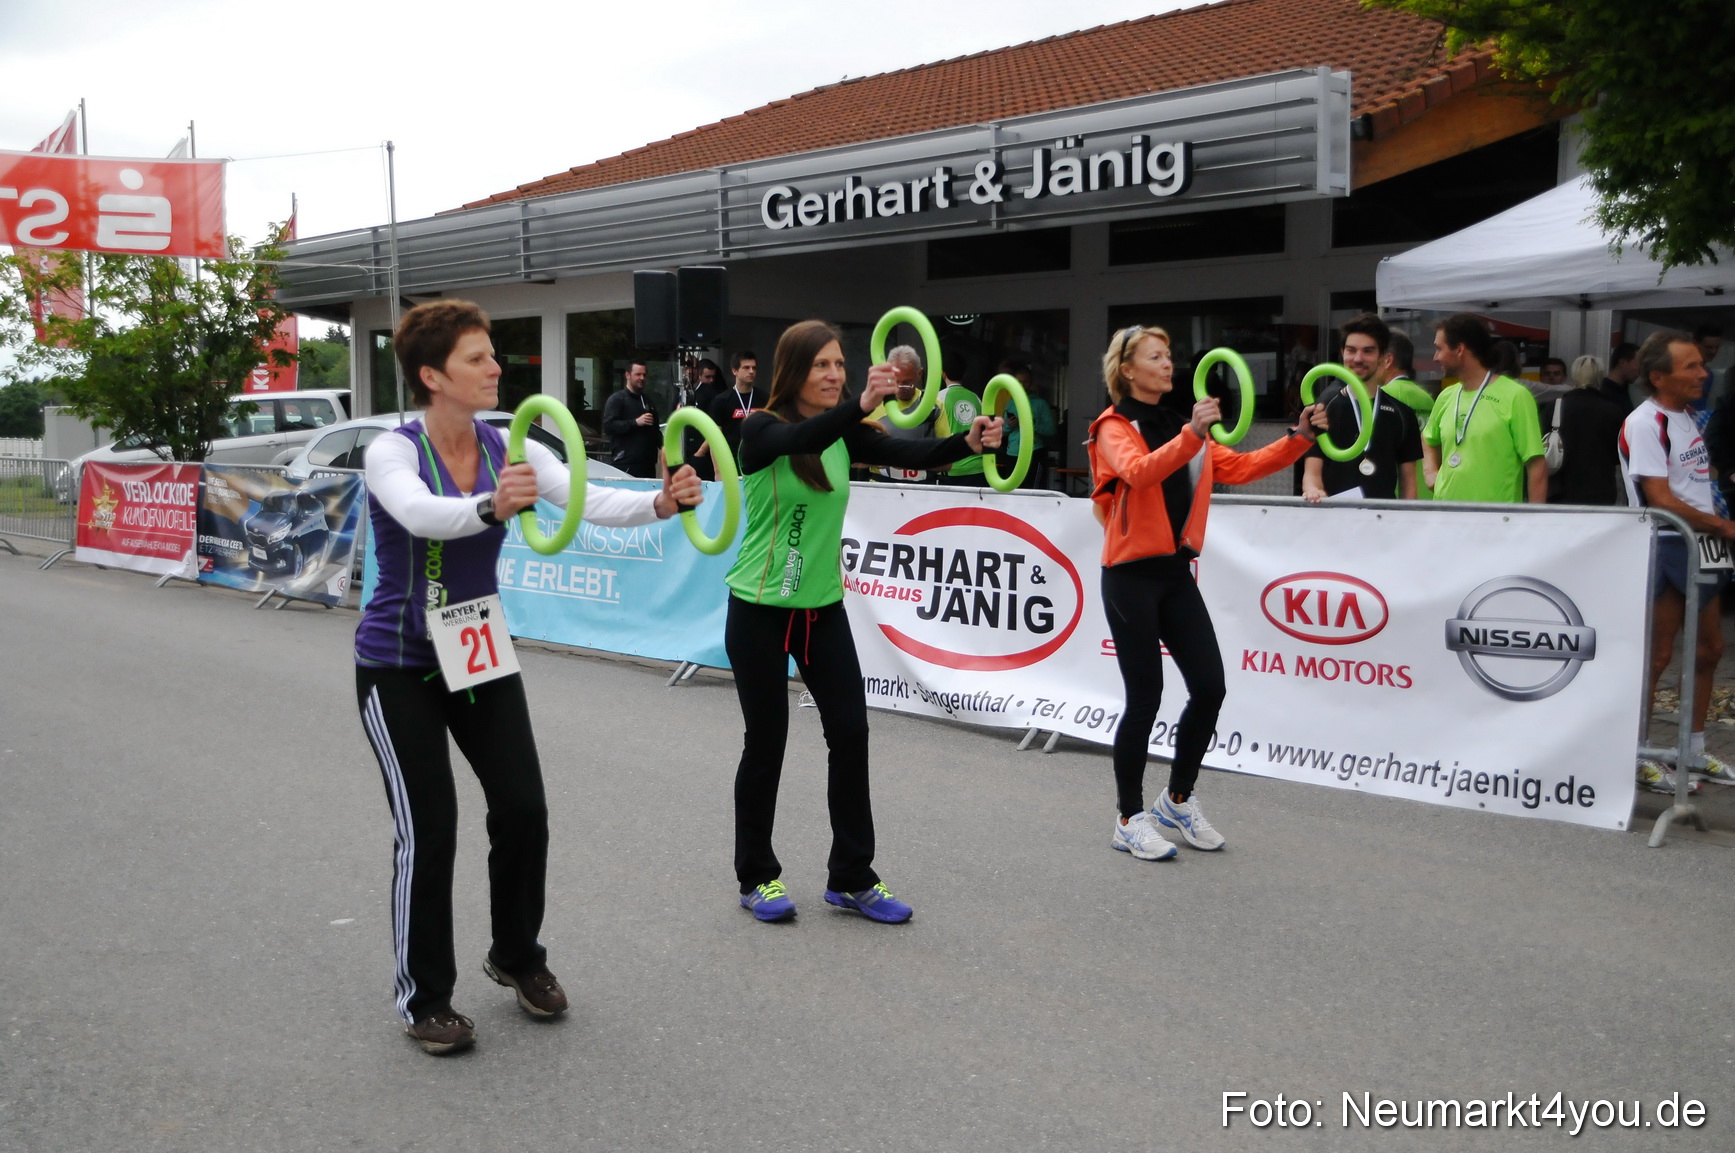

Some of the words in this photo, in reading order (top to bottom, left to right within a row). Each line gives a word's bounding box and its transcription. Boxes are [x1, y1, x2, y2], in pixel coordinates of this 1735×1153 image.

[761, 167, 951, 230] Gerhart
[968, 159, 1004, 205] &
[1023, 134, 1193, 197] Jänig
[1679, 446, 1707, 462] GERHAR
[573, 524, 663, 557] NISSAN
[788, 503, 808, 547] COACH
[425, 539, 444, 580] COAC
[522, 560, 620, 599] ERLEBT.
[840, 537, 1025, 591] GERHART
[1030, 564, 1047, 585] &
[843, 574, 922, 603] Autohaus
[916, 584, 1055, 634] JÄNIG
[1283, 588, 1367, 630] KIA
[441, 604, 476, 621] MEYER
[443, 614, 479, 627] WERBUNG
[460, 623, 500, 675] 21
[1459, 627, 1580, 652] NISSAN
[1241, 649, 1286, 675] KIA
[1294, 656, 1413, 690] MOTORS
[916, 681, 1015, 715] Sengenthal
[1031, 697, 1065, 721] Tel.
[1073, 705, 1120, 734] 091
[1268, 743, 1596, 809] www.gerhart-jaenig.de
